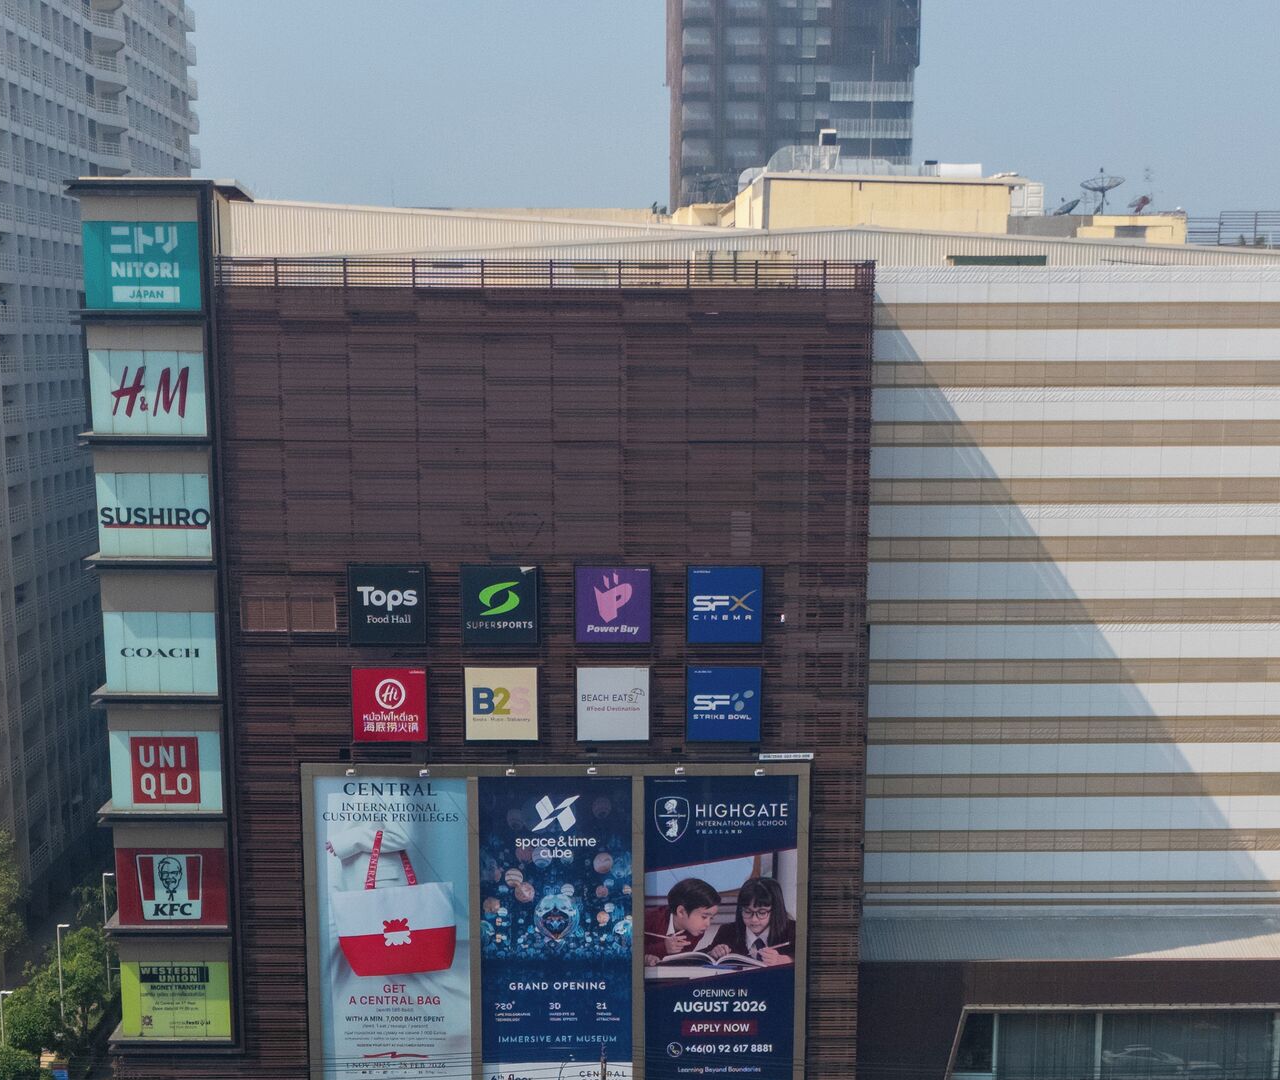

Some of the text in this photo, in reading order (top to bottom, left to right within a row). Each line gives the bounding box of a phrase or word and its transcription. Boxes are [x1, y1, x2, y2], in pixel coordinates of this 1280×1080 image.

[110, 226, 179, 254] ニトリ
[111, 261, 180, 279] NITORI
[129, 289, 164, 299] JAPAN
[110, 366, 190, 418] H&M
[100, 506, 211, 526] SUSHIRO
[356, 586, 418, 611] Tops
[692, 589, 758, 612] SFX
[366, 614, 411, 624] Food Hall
[466, 620, 534, 629] SUPERSPORTS
[586, 625, 639, 635] Power Buy
[120, 647, 200, 658] COACH
[381, 684, 398, 703] Hi
[581, 693, 634, 702] BEACH EATS
[472, 687, 531, 715] B2S
[693, 694, 731, 711] SF
[138, 745, 187, 768] UNI
[140, 773, 193, 799] QLO
[343, 782, 438, 796] CENTRAL
[341, 802, 439, 812] INTERNATIONAL
[695, 803, 789, 818] HIGHGATE
[322, 812, 459, 822] CUSTOMER PRIVILEGES
[695, 819, 755, 827] INTERNATIONAL
[515, 836, 597, 849] space & time
[539, 846, 573, 858] cube
[152, 903, 193, 917] KFC
[141, 967, 198, 975] WESTERN
[159, 974, 198, 982] UNION
[383, 984, 407, 993] GET
[508, 981, 606, 991] GRAND OPENING
[692, 989, 748, 998] OPENING IN
[349, 996, 441, 1005] A CENTRAL BAG
[595, 1002, 607, 1010] 21
[673, 1001, 767, 1013] AUGUST 2026
[690, 1023, 750, 1033] APPLY NOW
[498, 1035, 617, 1043] IMMERSIVE ART MUSEUM
[685, 1044, 773, 1055] +66(0) 92 617 8881
[579, 1070, 627, 1078] CENRAL
[677, 1066, 704, 1074] Learning
[704, 1066, 727, 1074] Beyond
